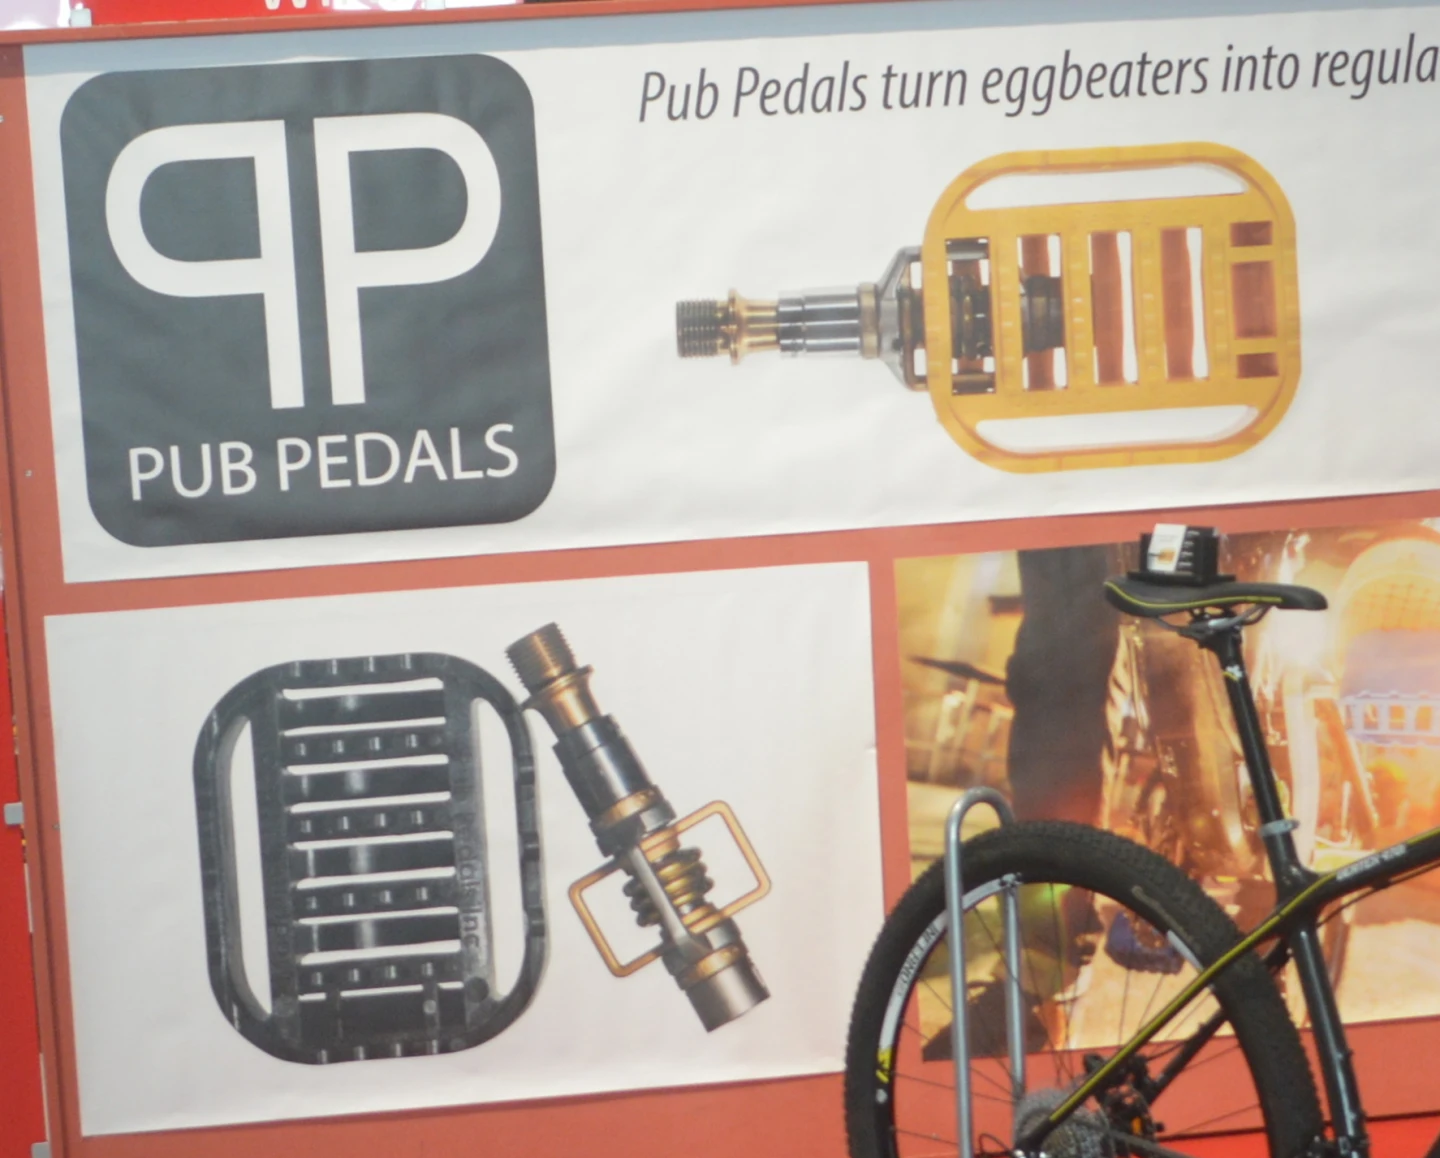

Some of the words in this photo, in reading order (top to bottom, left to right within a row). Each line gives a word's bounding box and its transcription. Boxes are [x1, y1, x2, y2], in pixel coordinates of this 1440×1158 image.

[638, 70, 720, 122] Pub
[733, 60, 868, 118] Pedals
[881, 64, 967, 110] turn
[981, 49, 1209, 117] eggbeaters
[1221, 44, 1300, 92] into
[128, 441, 257, 501] PUB
[276, 423, 519, 491] PEDALS
